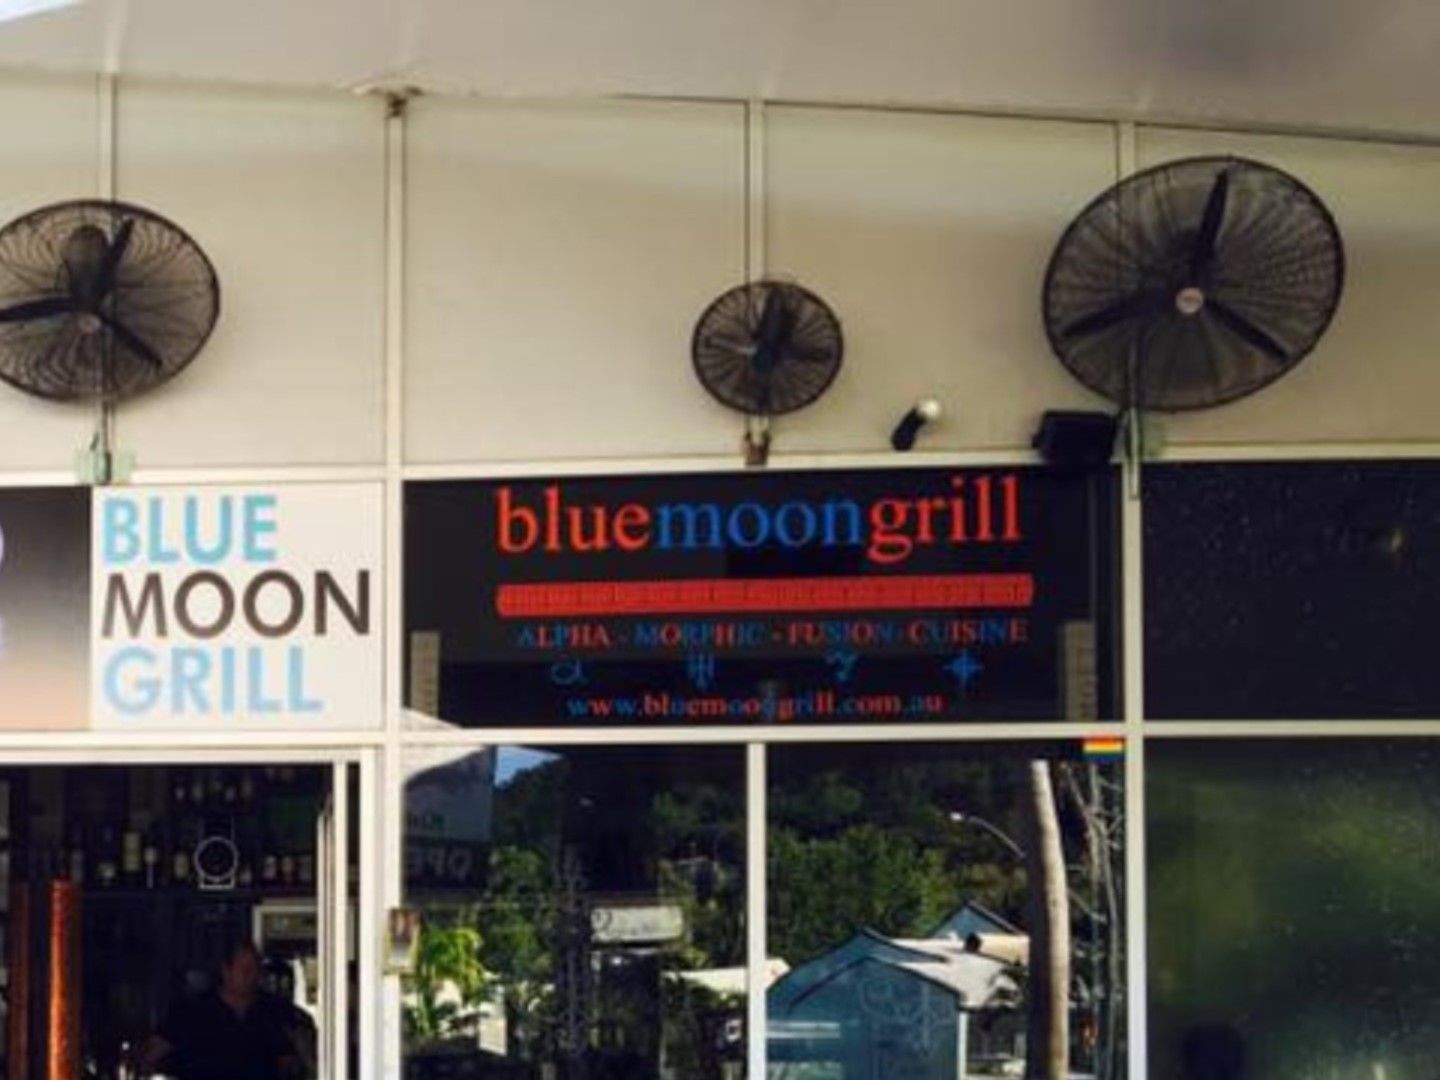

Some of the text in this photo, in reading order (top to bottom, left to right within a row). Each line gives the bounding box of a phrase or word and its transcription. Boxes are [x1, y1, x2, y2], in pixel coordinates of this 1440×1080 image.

[102, 494, 278, 564] BLUE
[497, 476, 1022, 563] bluemoongrill
[101, 568, 371, 639] MOON
[517, 622, 611, 648] ALPHA
[633, 621, 767, 647] MORPHIC
[907, 616, 1029, 643] CUISINE
[103, 645, 325, 715] GRILL
